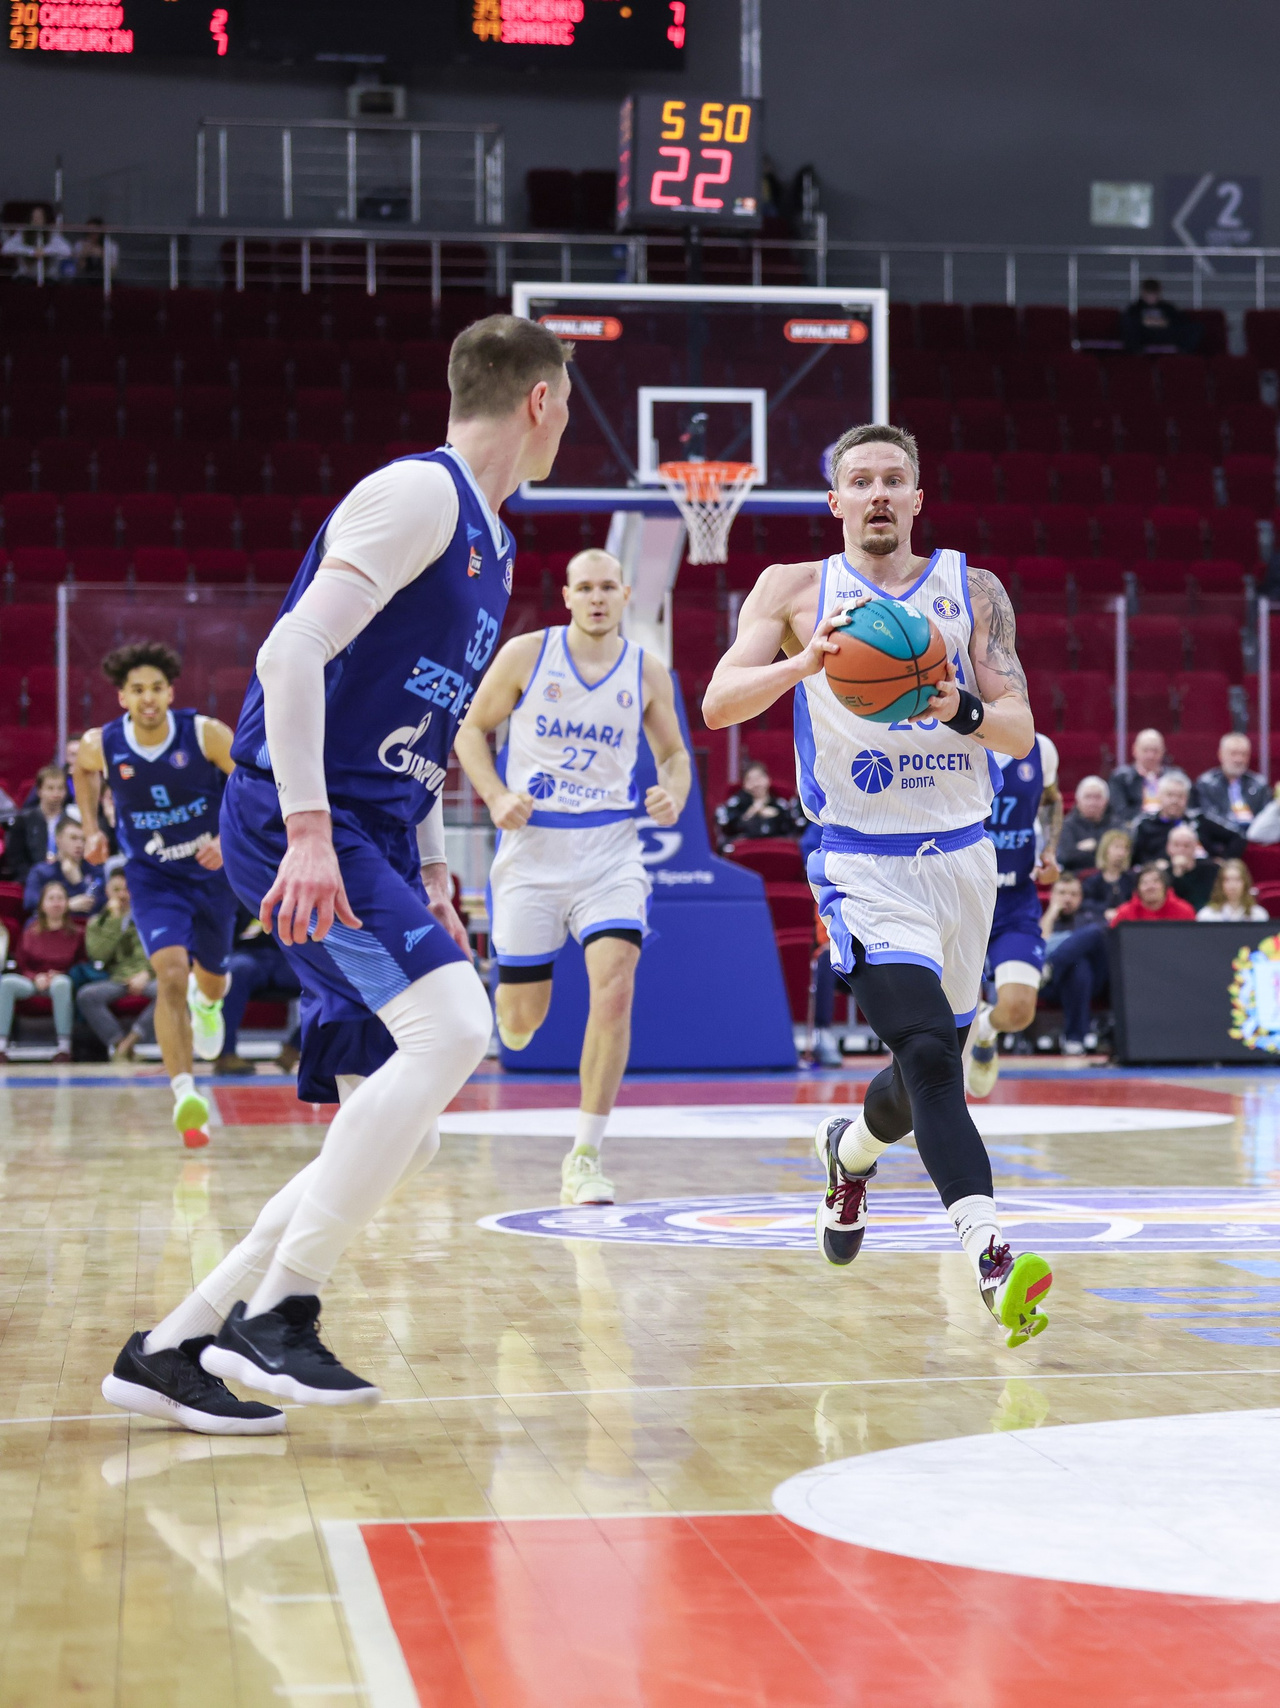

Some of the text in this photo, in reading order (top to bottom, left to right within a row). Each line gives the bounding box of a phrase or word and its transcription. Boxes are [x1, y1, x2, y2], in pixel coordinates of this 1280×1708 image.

[10, 3, 39, 26] 30
[210, 9, 228, 33] 2
[669, 1, 686, 26] 7
[9, 26, 39, 49] 53
[212, 33, 228, 56] 7
[667, 25, 686, 49] 4
[661, 101, 751, 143] 5 50
[650, 146, 733, 208] 22
[1216, 182, 1243, 229] 2
[790, 323, 849, 340] WINLINE
[464, 607, 499, 671] 33
[535, 714, 624, 748] SAMARA
[560, 746, 598, 772] 27
[150, 784, 171, 808] 9
[901, 776, 935, 789] ВОЛГА
[990, 796, 1018, 825] 17
